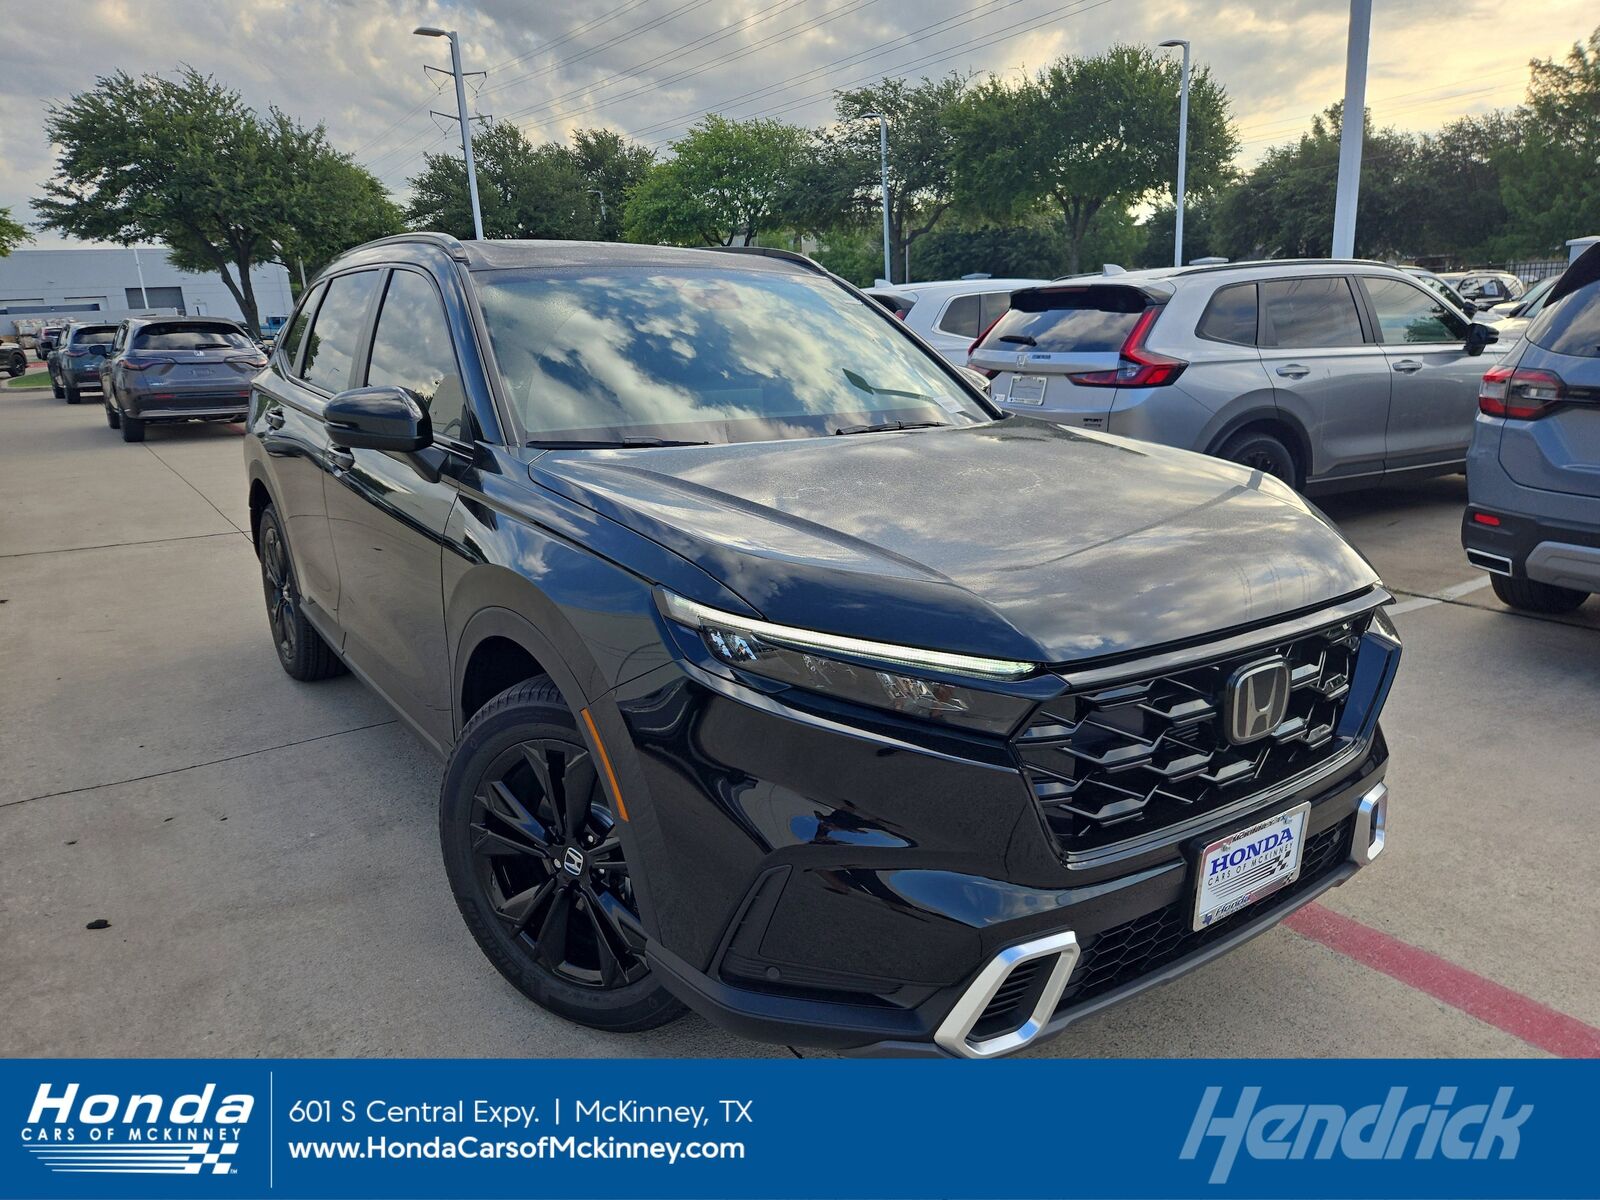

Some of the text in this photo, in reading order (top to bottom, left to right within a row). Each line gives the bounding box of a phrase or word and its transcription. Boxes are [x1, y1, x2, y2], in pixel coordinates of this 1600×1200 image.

[1208, 842, 1293, 886] CARS OF MCKINNEY
[1210, 828, 1294, 876] HONDA
